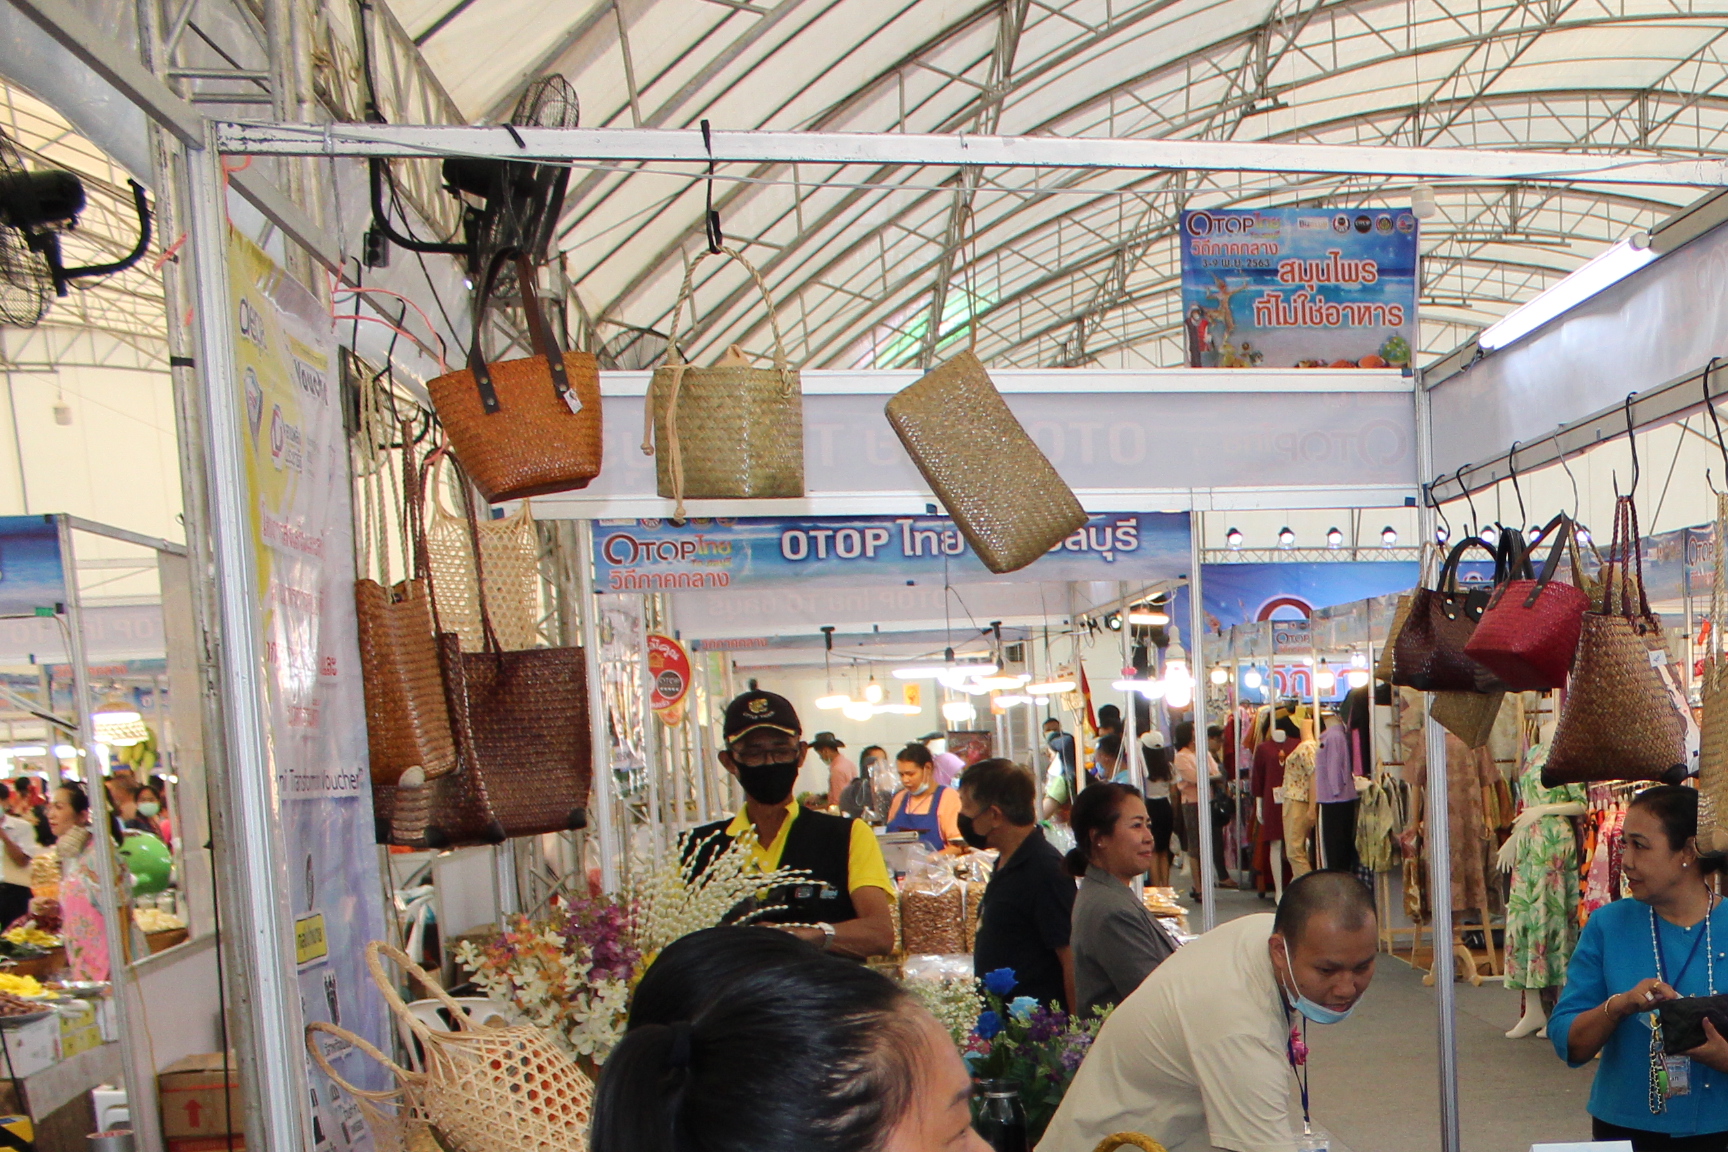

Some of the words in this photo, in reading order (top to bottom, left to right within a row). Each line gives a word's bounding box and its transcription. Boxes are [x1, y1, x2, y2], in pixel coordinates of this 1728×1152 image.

[1187, 210, 1253, 237] OTOP
[1191, 239, 1278, 256] วิถีภาคกลาง
[1247, 259, 1270, 267] 2563
[1278, 251, 1377, 291] สมุนไพร
[602, 532, 697, 566] OTOP
[781, 528, 889, 560] OTOP
[610, 569, 730, 590] วิถีภาคกลาง
